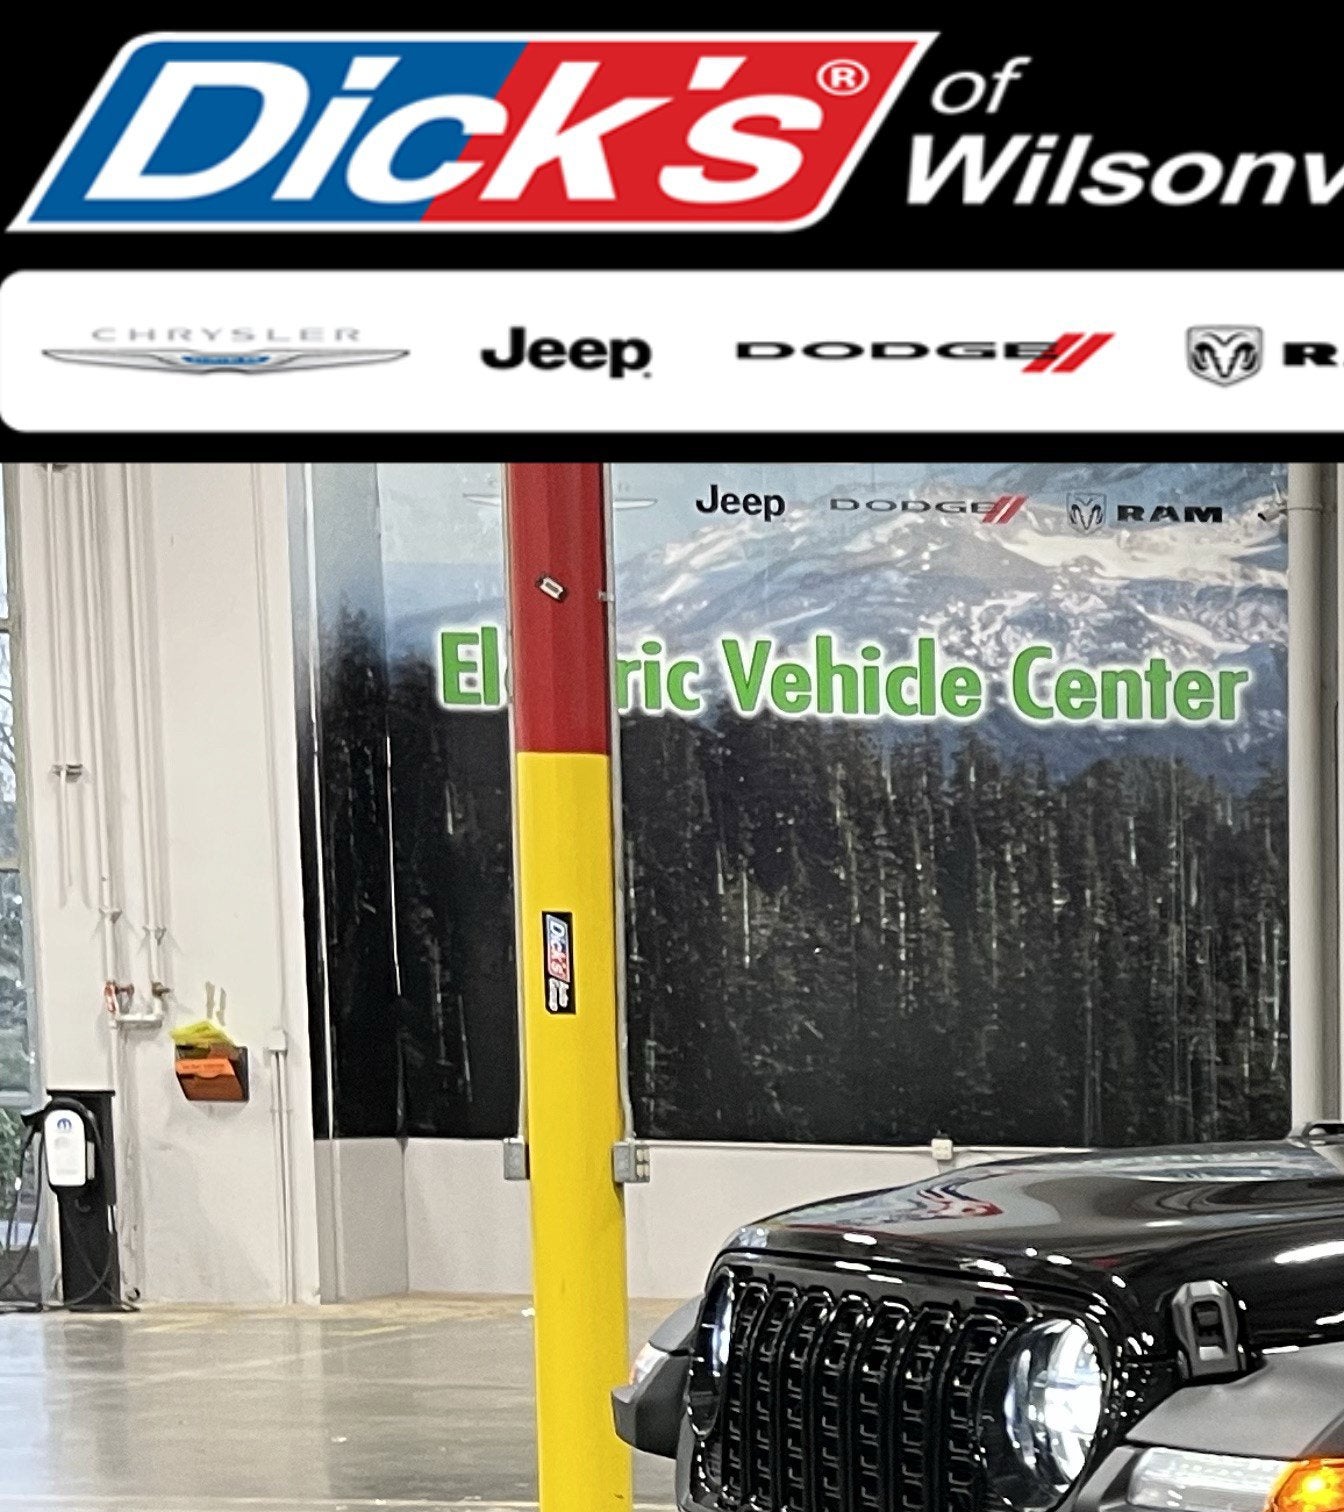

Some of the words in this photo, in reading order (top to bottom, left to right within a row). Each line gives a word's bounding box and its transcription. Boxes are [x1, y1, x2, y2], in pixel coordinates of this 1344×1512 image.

[695, 484, 786, 523] Jeep
[829, 497, 995, 515] DODGE
[1116, 504, 1224, 523] RAM
[441, 626, 701, 710] Elric
[722, 634, 982, 717] Vehicle
[1011, 647, 1248, 721] Center
